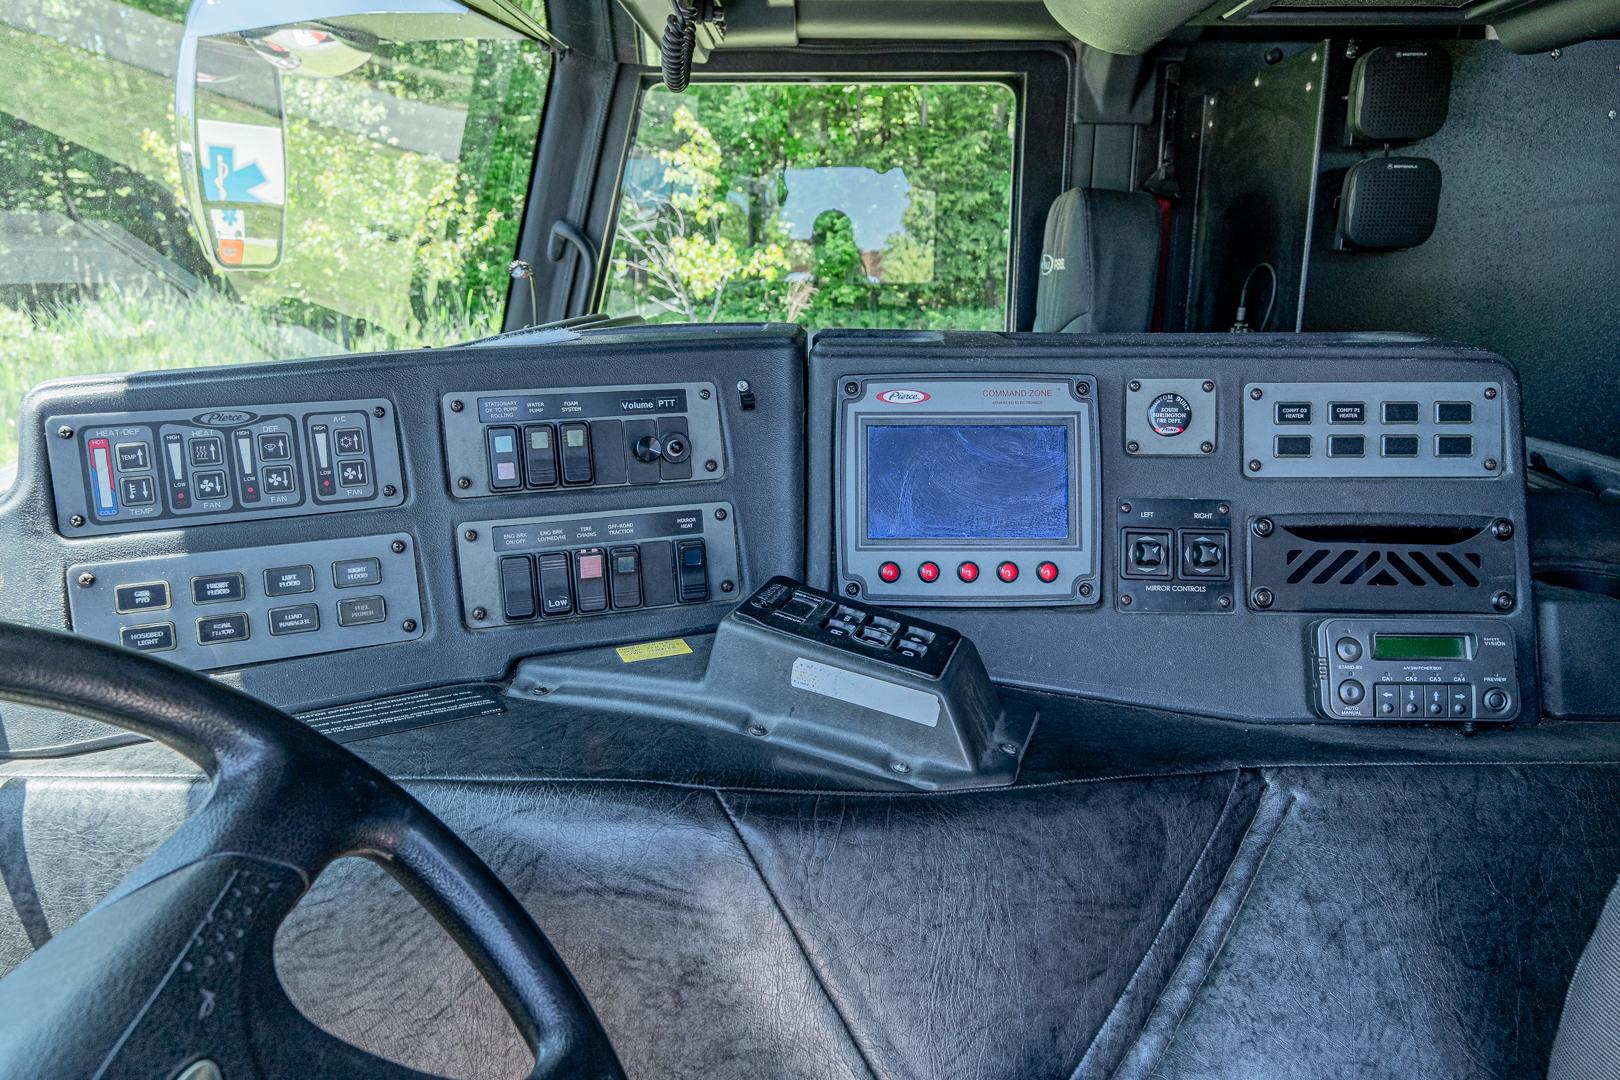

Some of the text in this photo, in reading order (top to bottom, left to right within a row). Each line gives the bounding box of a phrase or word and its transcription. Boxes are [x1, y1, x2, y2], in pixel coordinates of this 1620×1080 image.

[888, 392, 918, 400] Pierce
[622, 399, 675, 410] Volume PTT
[1176, 396, 1190, 410] BUILT
[208, 412, 242, 423] Pierce
[130, 507, 153, 516] TEMP
[131, 632, 164, 640] HOSEBED
